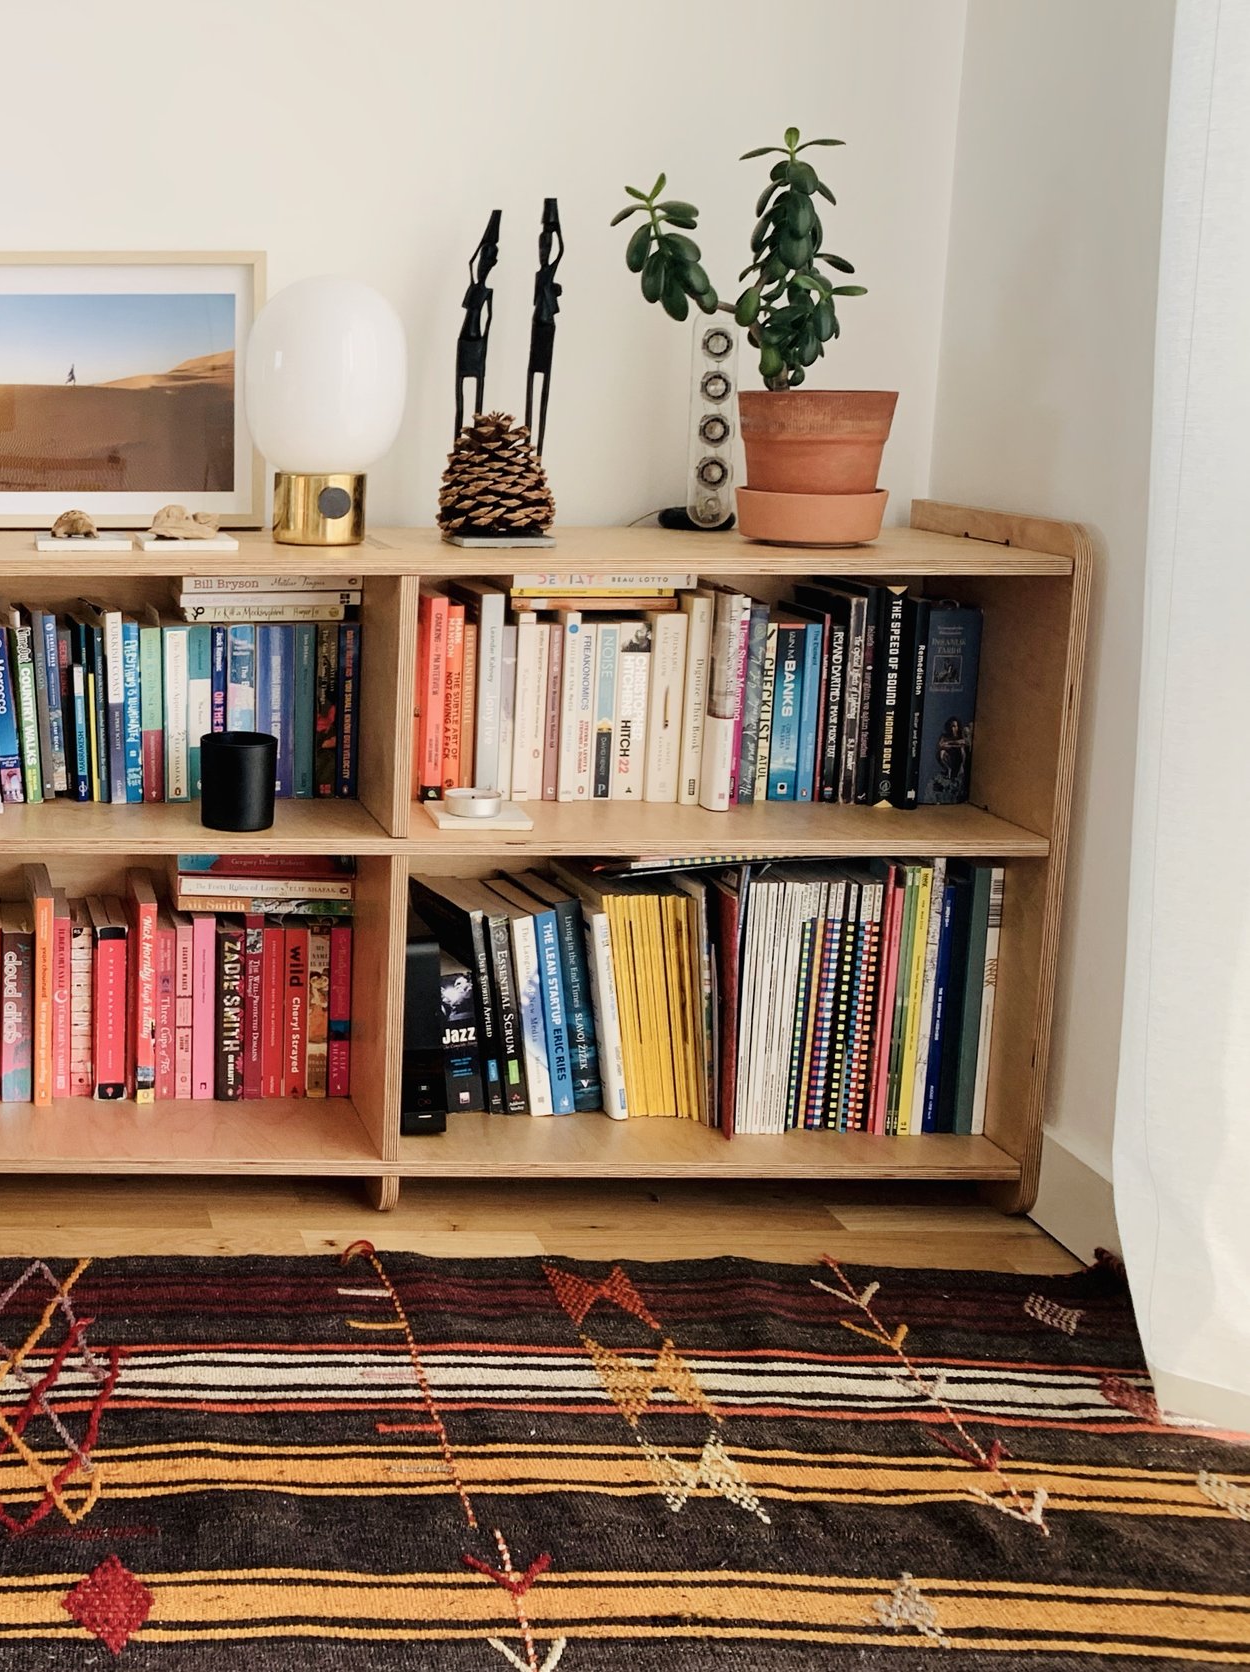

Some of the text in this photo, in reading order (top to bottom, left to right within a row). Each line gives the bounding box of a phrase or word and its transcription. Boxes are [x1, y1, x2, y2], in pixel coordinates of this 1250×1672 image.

[194, 579, 259, 590] Bill Bryson
[216, 632, 224, 671] Jack Kerouac
[447, 618, 455, 658] MANSON
[600, 635, 614, 678] NOISE
[885, 600, 902, 706] THE SPEED OF SOUND
[345, 680, 353, 692] YOU
[445, 672, 453, 691] NOT
[464, 631, 474, 725] BERTRAND RUSSELL
[581, 635, 592, 711] FREAKONOMICS
[781, 660, 796, 717] BANKS
[914, 645, 926, 696] Remediation
[20, 668, 34, 721] COUNTRY
[214, 691, 225, 725] ON THE
[344, 693, 352, 712] SHALL
[444, 693, 452, 724] GIVING
[618, 655, 634, 774] HITCHENS HITCH 22
[632, 656, 646, 740] CHRISTOPHER
[691, 658, 704, 754] Digitize This Book!
[25, 725, 37, 765] WALKS
[343, 714, 351, 733] KNOW
[882, 711, 894, 775] THOMAS DOLBY
[451, 748, 458, 760] OF
[140, 915, 155, 1038] Nick Hornby High Fidelity
[290, 946, 304, 987] wild
[543, 922, 561, 1025] THE LEAN STARTUP
[564, 916, 581, 1007] Living in the End Times
[3, 951, 22, 1043] cloud atlas
[161, 996, 171, 1024] Three
[222, 941, 241, 1052] ZADIE SMITH
[160, 1027, 169, 1048] Cups
[290, 997, 301, 1073] Cheryl Strayed
[442, 1027, 476, 1045] Jazz
[574, 1012, 585, 1042] SLAVOJ
[160, 1058, 170, 1074] Tea
[553, 1028, 567, 1081] ERIC RIES
